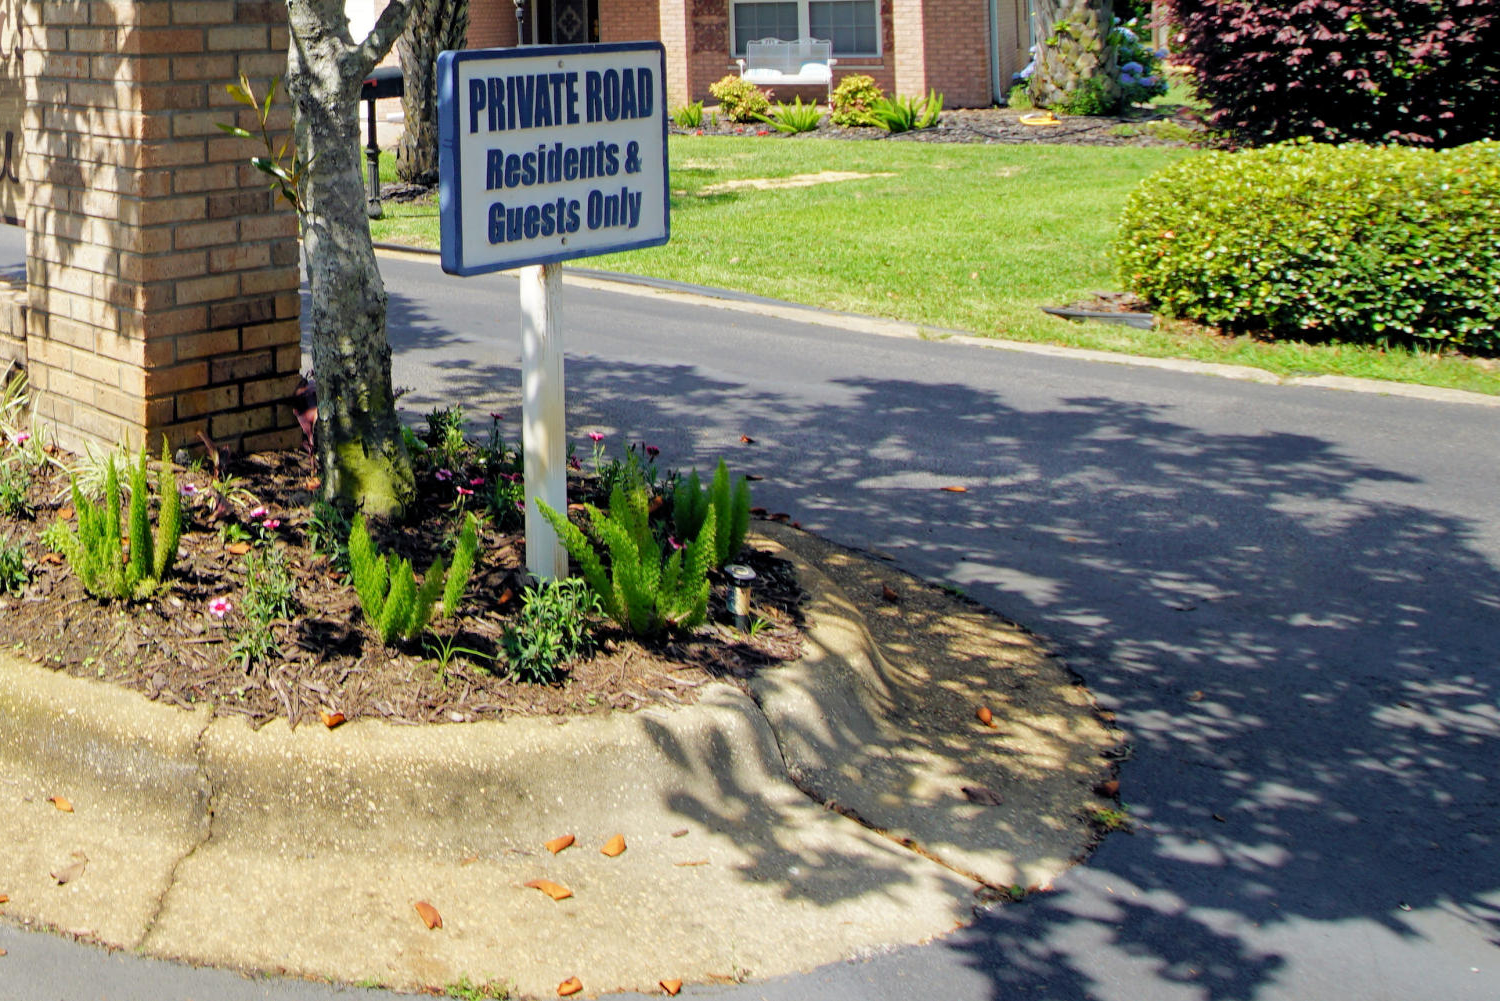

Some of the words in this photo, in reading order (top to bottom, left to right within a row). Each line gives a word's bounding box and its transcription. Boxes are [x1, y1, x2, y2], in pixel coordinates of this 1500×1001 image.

[468, 71, 580, 134] PRIVATE
[585, 67, 654, 124] ROAD
[486, 141, 620, 191] Residents
[624, 140, 643, 174] &
[487, 197, 581, 245] Guests
[587, 186, 643, 230] Only
